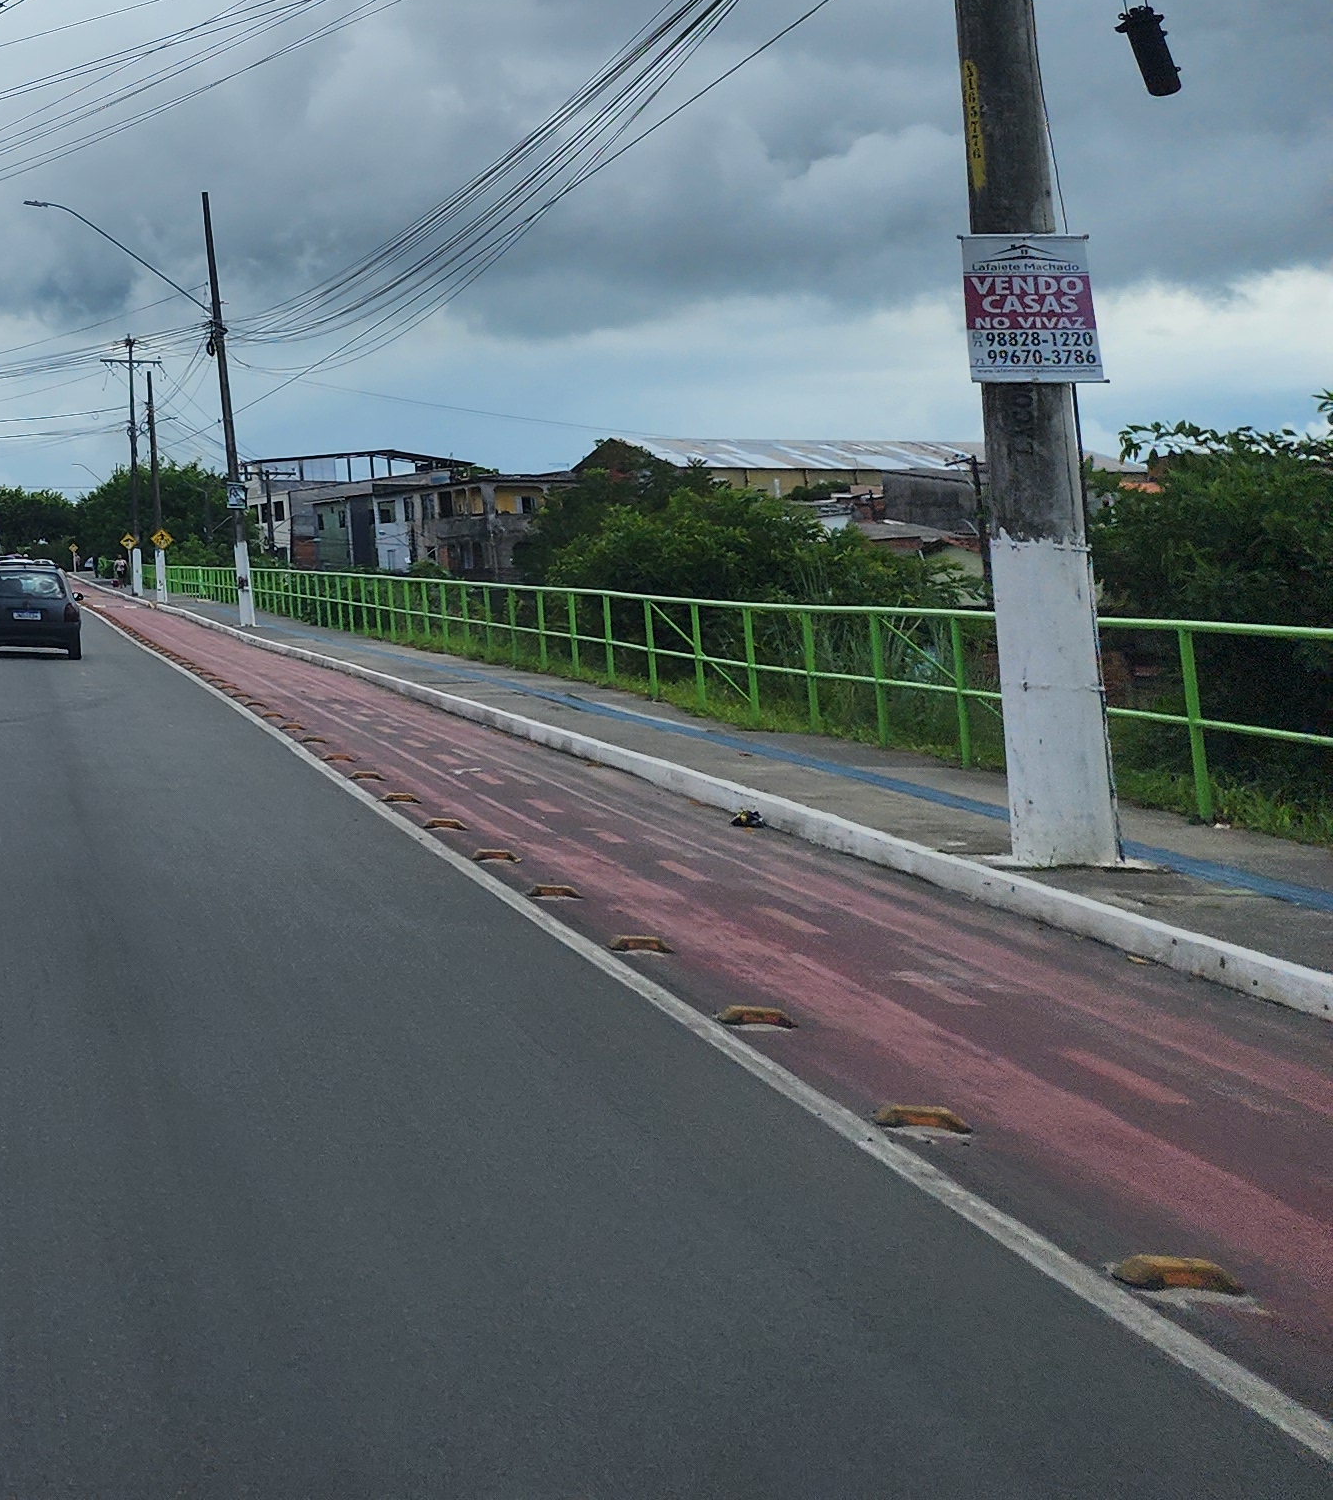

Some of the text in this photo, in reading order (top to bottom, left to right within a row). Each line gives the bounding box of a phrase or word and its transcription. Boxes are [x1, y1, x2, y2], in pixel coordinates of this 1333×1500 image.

[971, 262, 1080, 272] Lafaiete Machado
[970, 276, 1084, 295] VENDO
[981, 295, 1079, 314] CASAS
[974, 316, 1086, 329] NO VIVAZ
[985, 331, 1094, 347] 98828-1220
[987, 349, 1097, 365] 99670-3786
